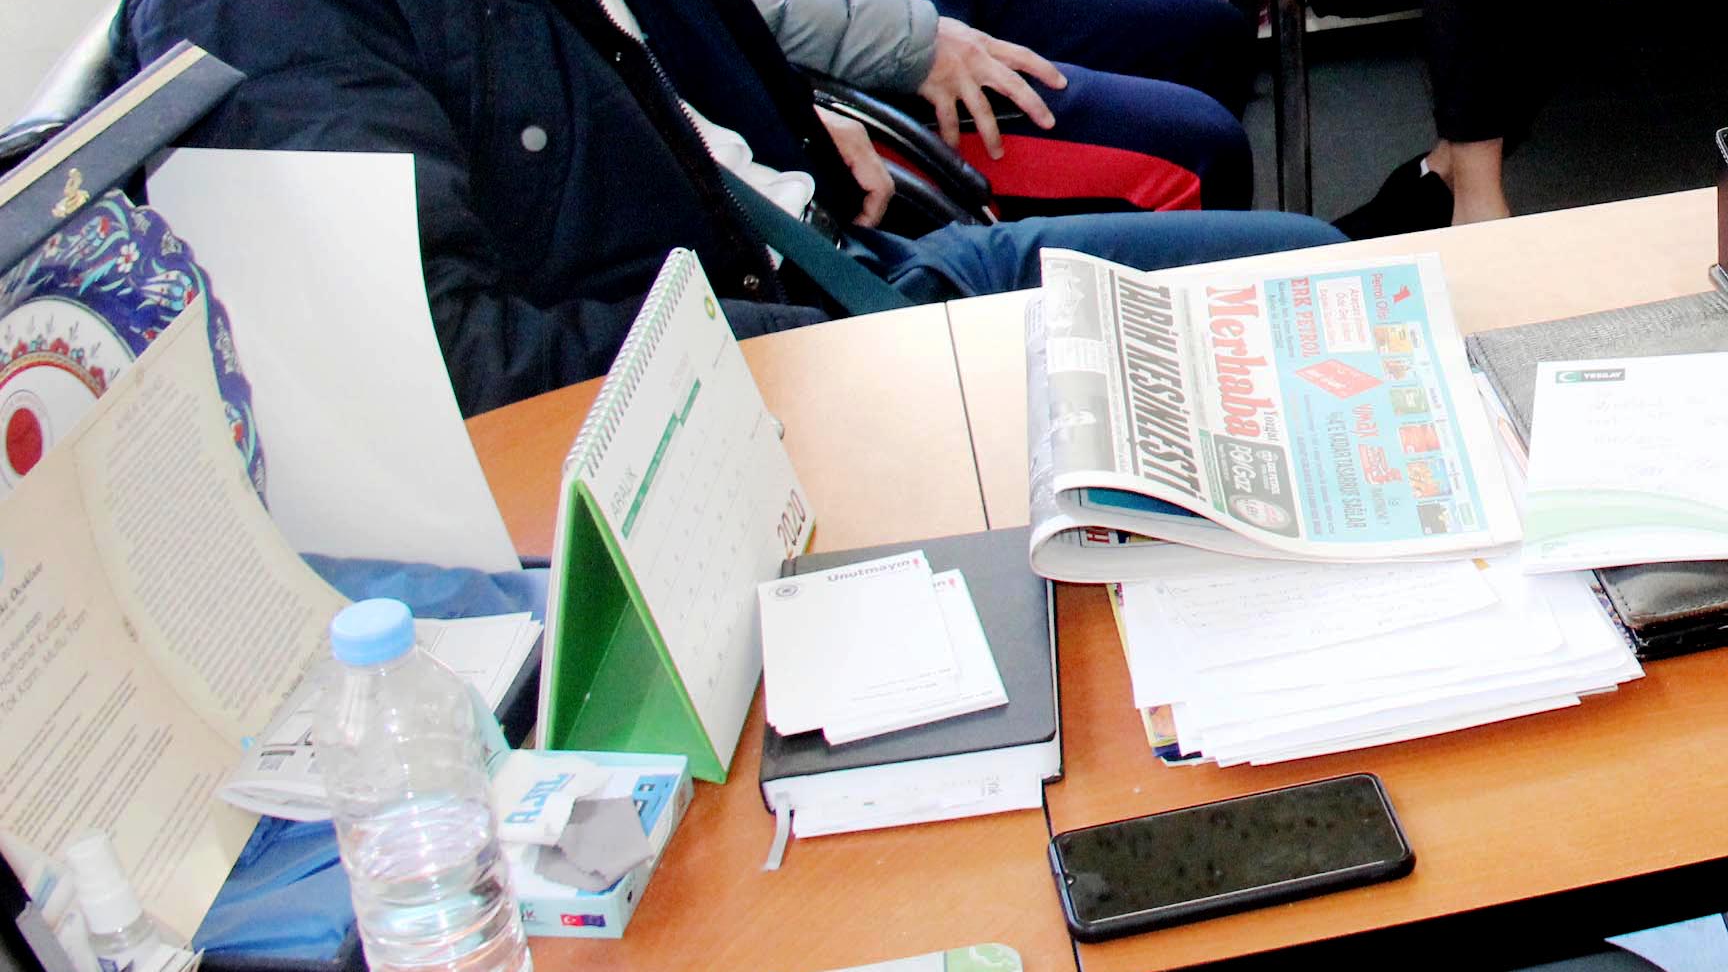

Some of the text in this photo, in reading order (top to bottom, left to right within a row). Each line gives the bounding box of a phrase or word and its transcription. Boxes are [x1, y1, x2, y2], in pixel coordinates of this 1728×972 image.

[1118, 275, 1179, 347] TARİH
[1207, 284, 1274, 437] Merhaba
[777, 488, 806, 554] 2020
